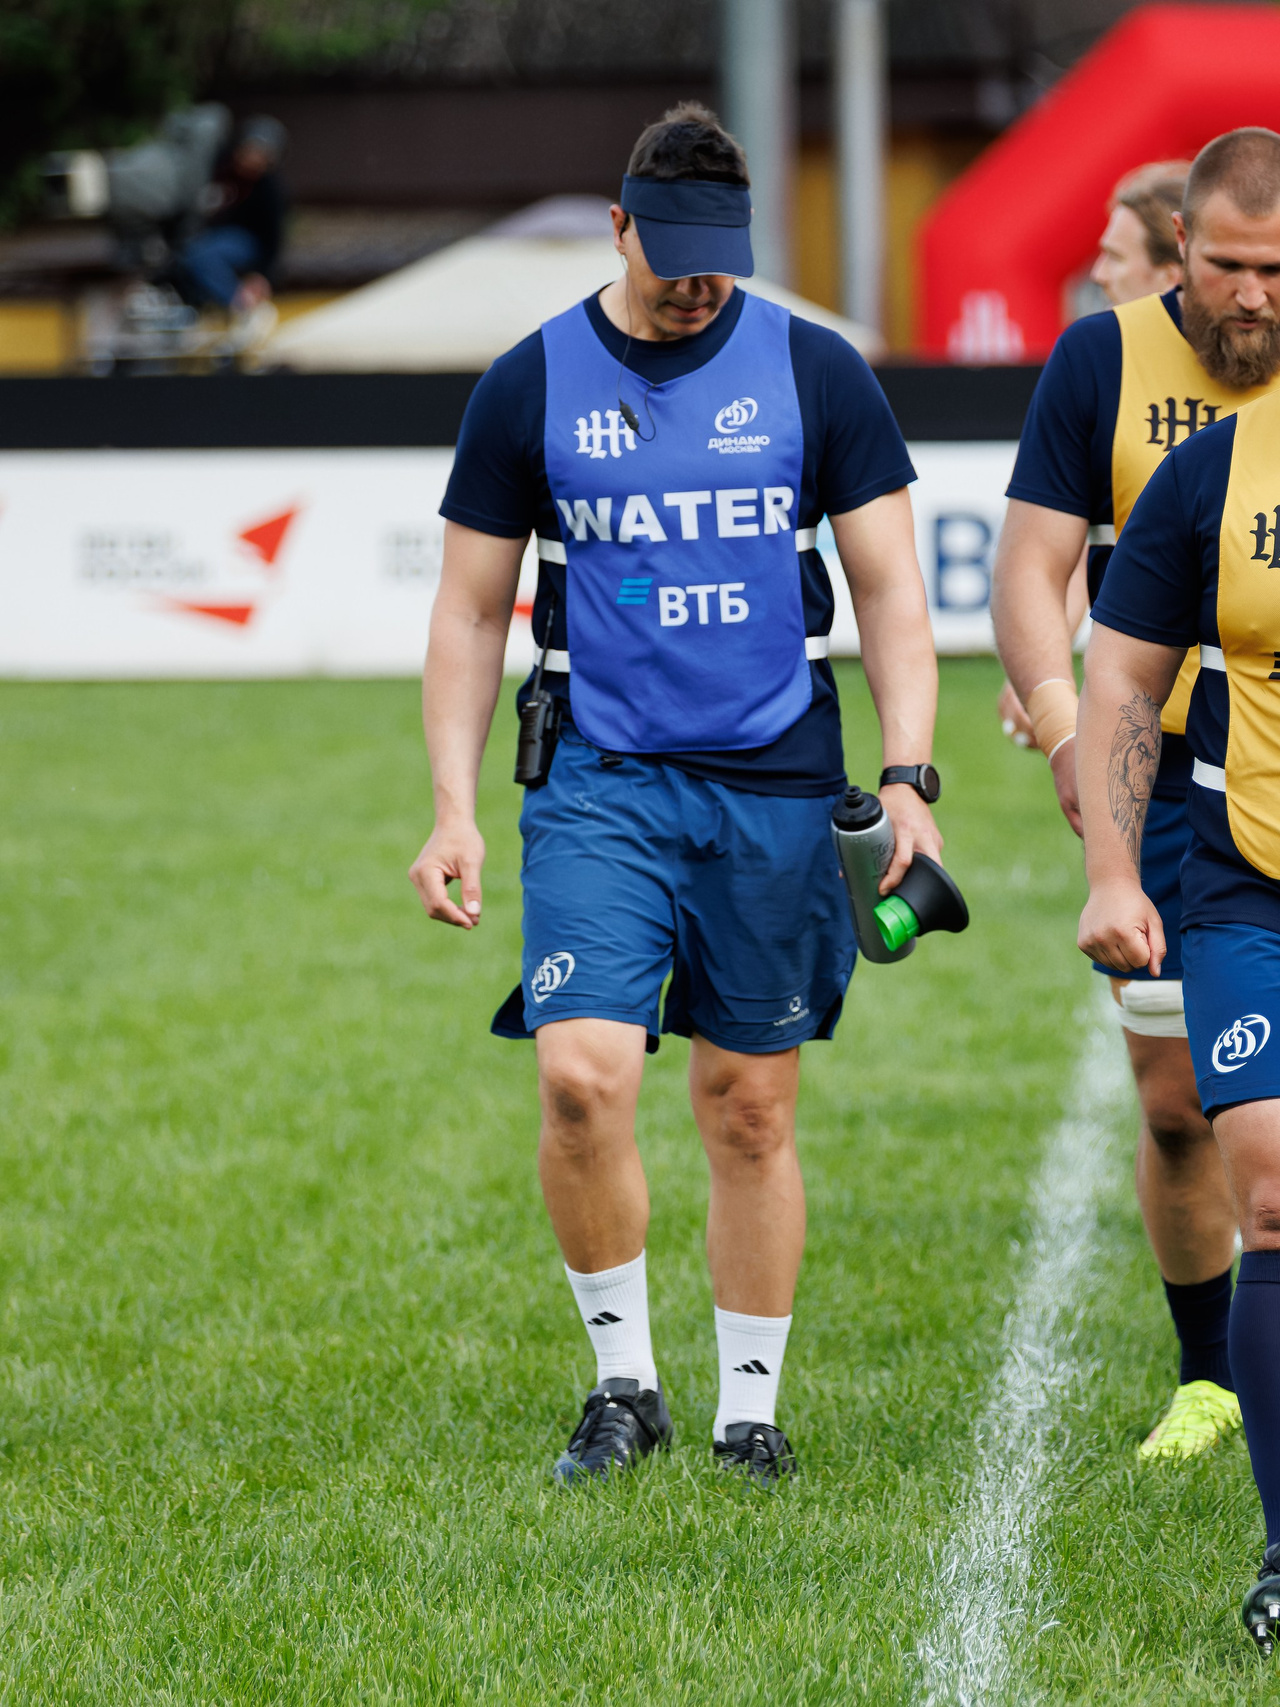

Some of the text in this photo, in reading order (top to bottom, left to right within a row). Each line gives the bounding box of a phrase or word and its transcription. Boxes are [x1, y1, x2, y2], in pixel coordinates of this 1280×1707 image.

[708, 435, 770, 450] ДИНАМО
[719, 445, 761, 454] МОСКВА
[556, 486, 794, 542] WATER
[658, 582, 750, 627] ВТБ
